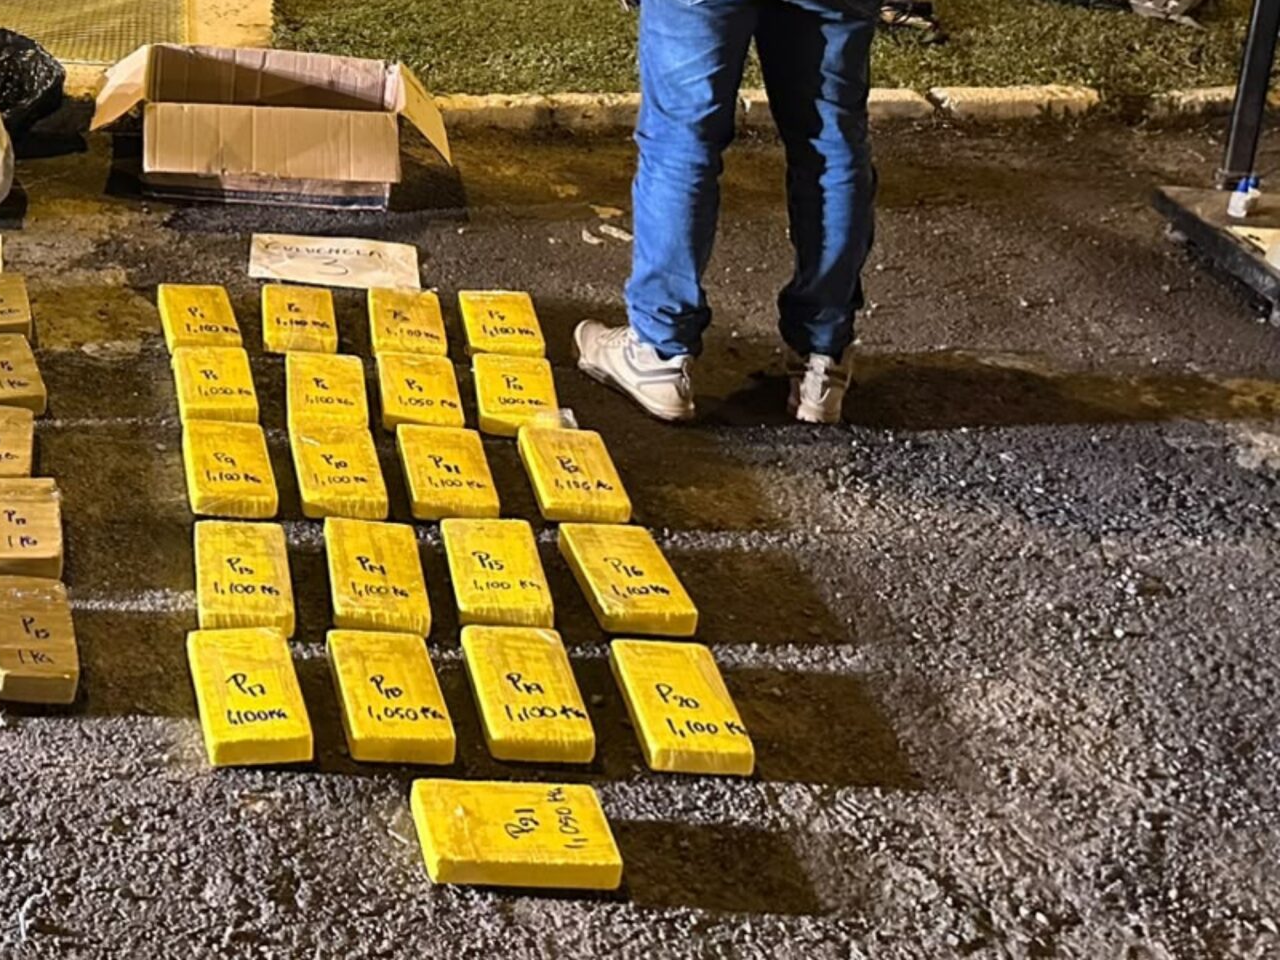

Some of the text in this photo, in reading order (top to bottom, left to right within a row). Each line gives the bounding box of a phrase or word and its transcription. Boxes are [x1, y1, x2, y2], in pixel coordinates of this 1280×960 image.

[318, 258, 349, 277] 3
[471, 549, 506, 572] P15
[602, 556, 645, 578] P16
[225, 672, 266, 698] P17
[655, 682, 701, 710] P20
